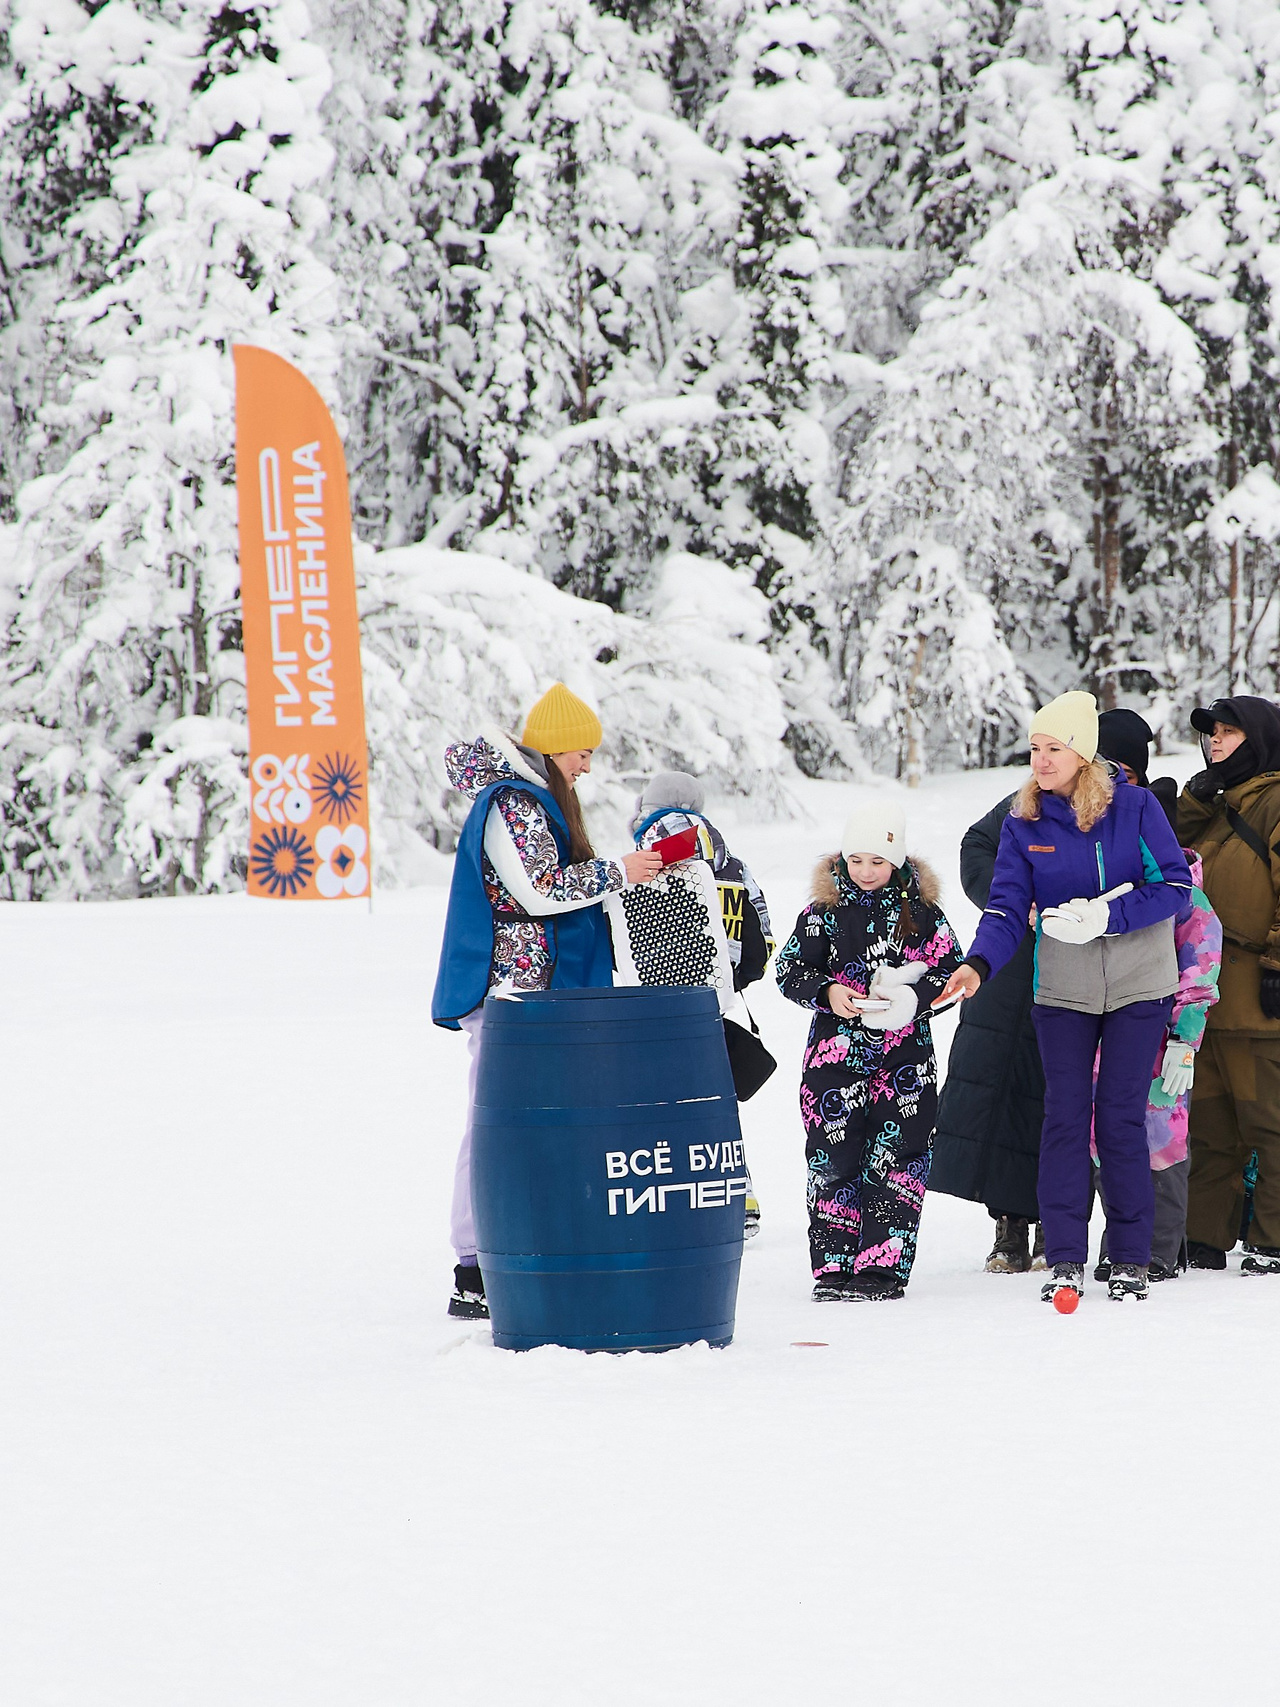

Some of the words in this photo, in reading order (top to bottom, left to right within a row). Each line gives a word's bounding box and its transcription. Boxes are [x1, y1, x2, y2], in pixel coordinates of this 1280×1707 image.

[259, 446, 303, 727] ГИПЕР
[291, 439, 338, 727] МАСЛЕНИЦА
[898, 1103, 919, 1119] TRIP
[826, 1129, 846, 1146] TRIP
[605, 1140, 673, 1179] ВСЁ
[607, 1176, 747, 1216] ГИПЕР
